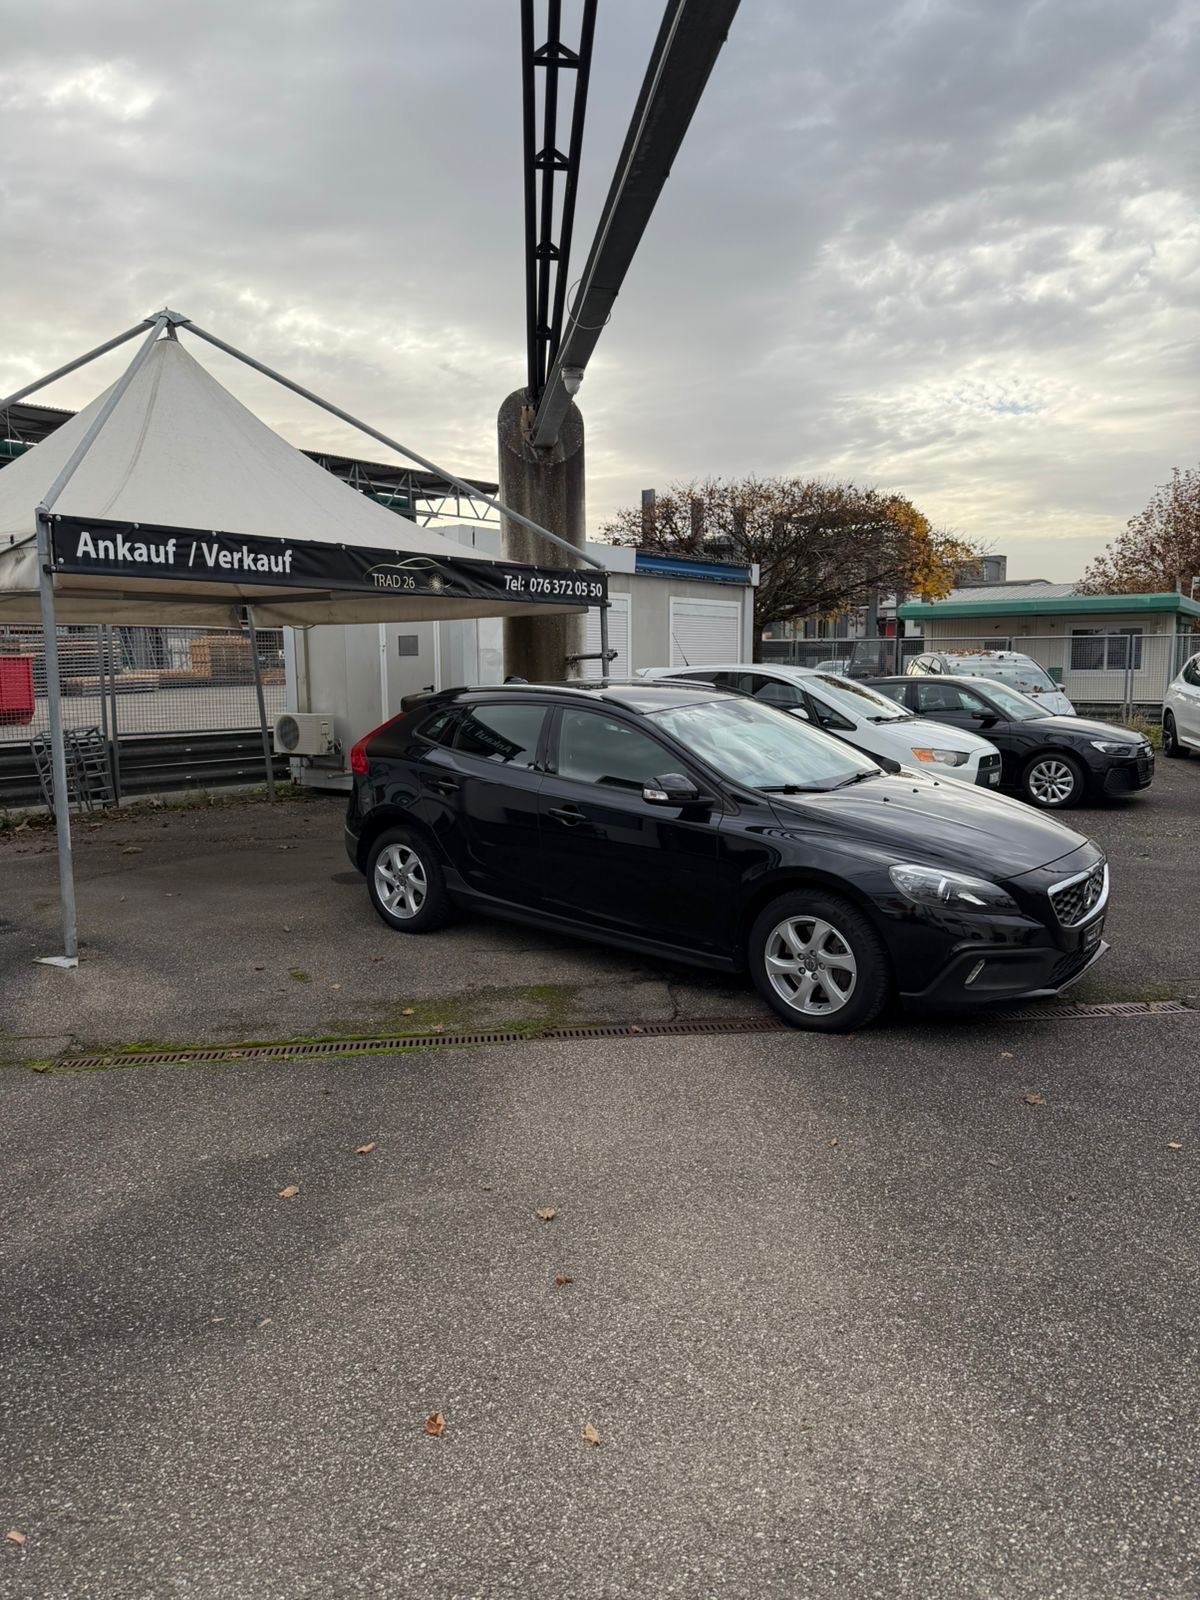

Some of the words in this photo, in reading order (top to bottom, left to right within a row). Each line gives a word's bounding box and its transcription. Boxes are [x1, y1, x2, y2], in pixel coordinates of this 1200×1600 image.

[76, 531, 177, 564] Ankauf
[372, 573, 401, 588] TRAD
[402, 576, 416, 589] 26
[504, 575, 525, 591] Tel:
[529, 577, 551, 593] 076
[552, 580, 573, 595] 372
[574, 581, 588, 596] 05
[590, 583, 603, 597] 50
